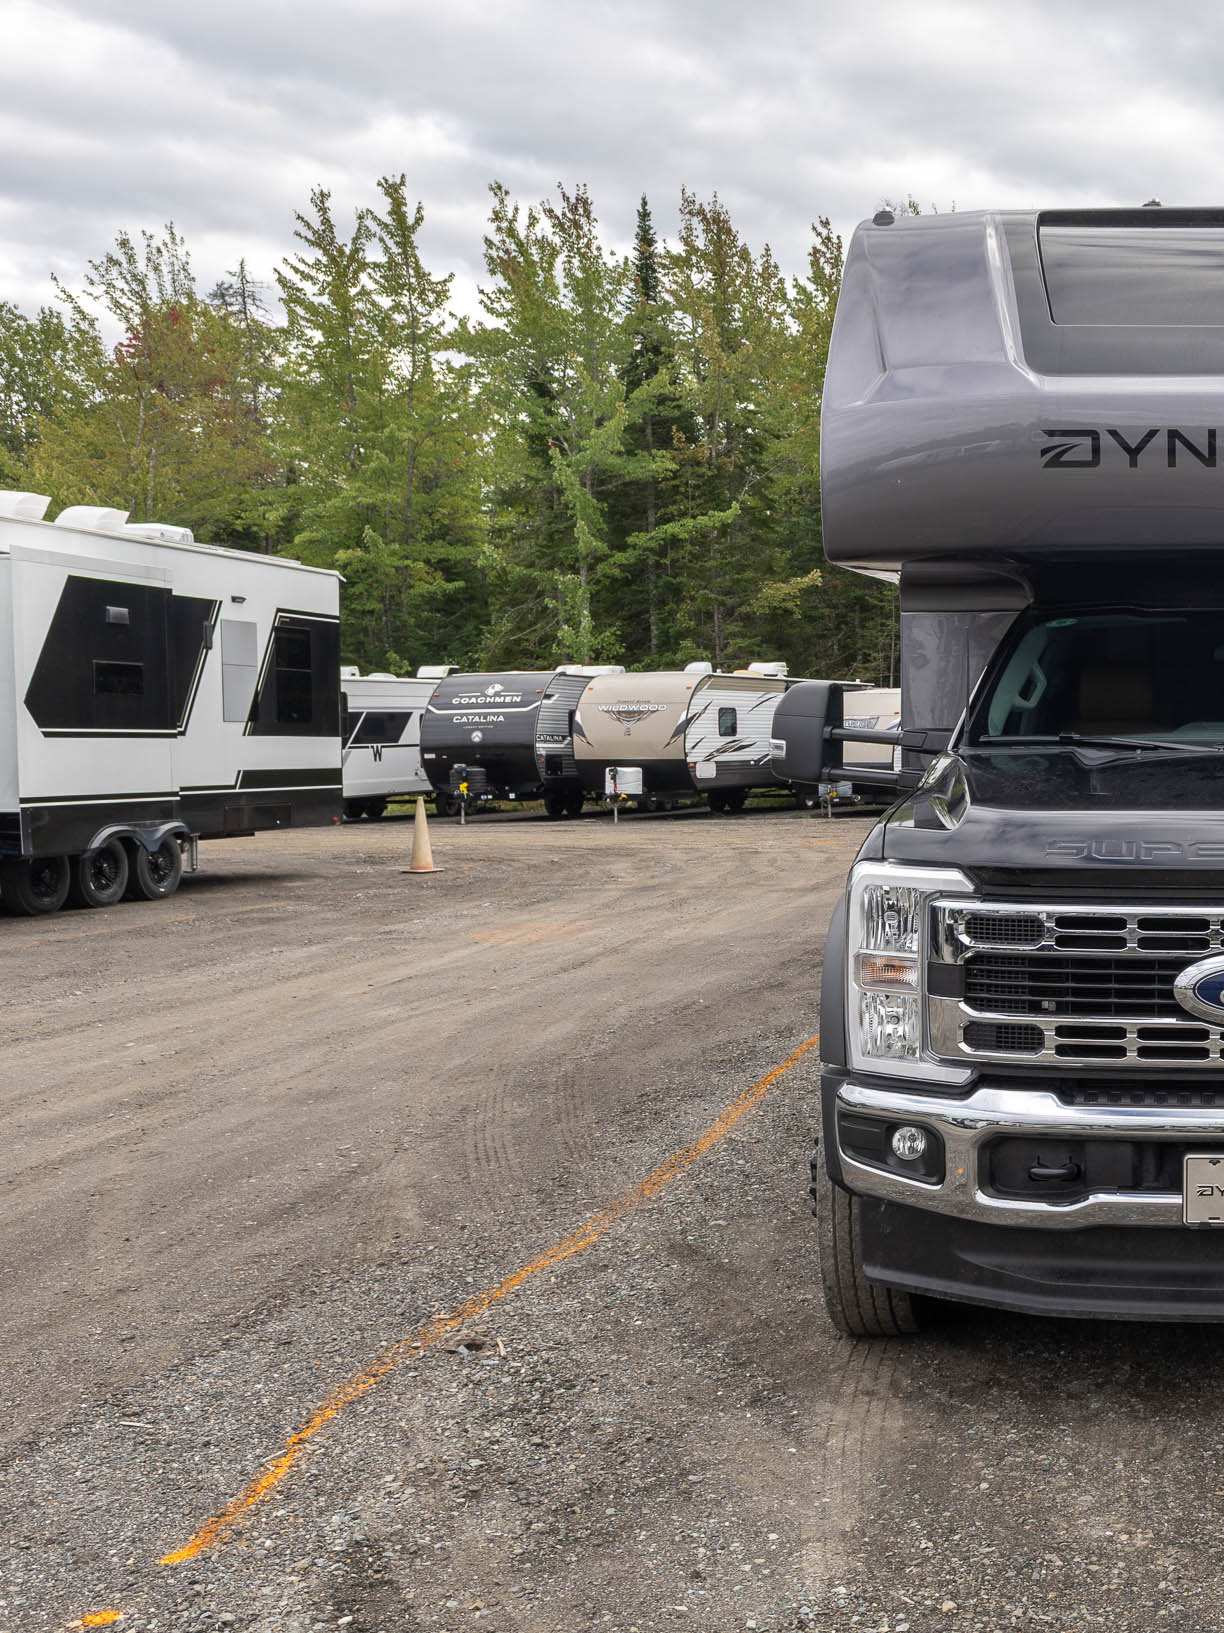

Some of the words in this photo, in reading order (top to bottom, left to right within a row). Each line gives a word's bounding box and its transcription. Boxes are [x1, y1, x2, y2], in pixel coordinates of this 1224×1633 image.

[451, 695, 522, 704] COACHMEN
[452, 715, 505, 723] CATALINA
[535, 734, 563, 742] CATALINA
